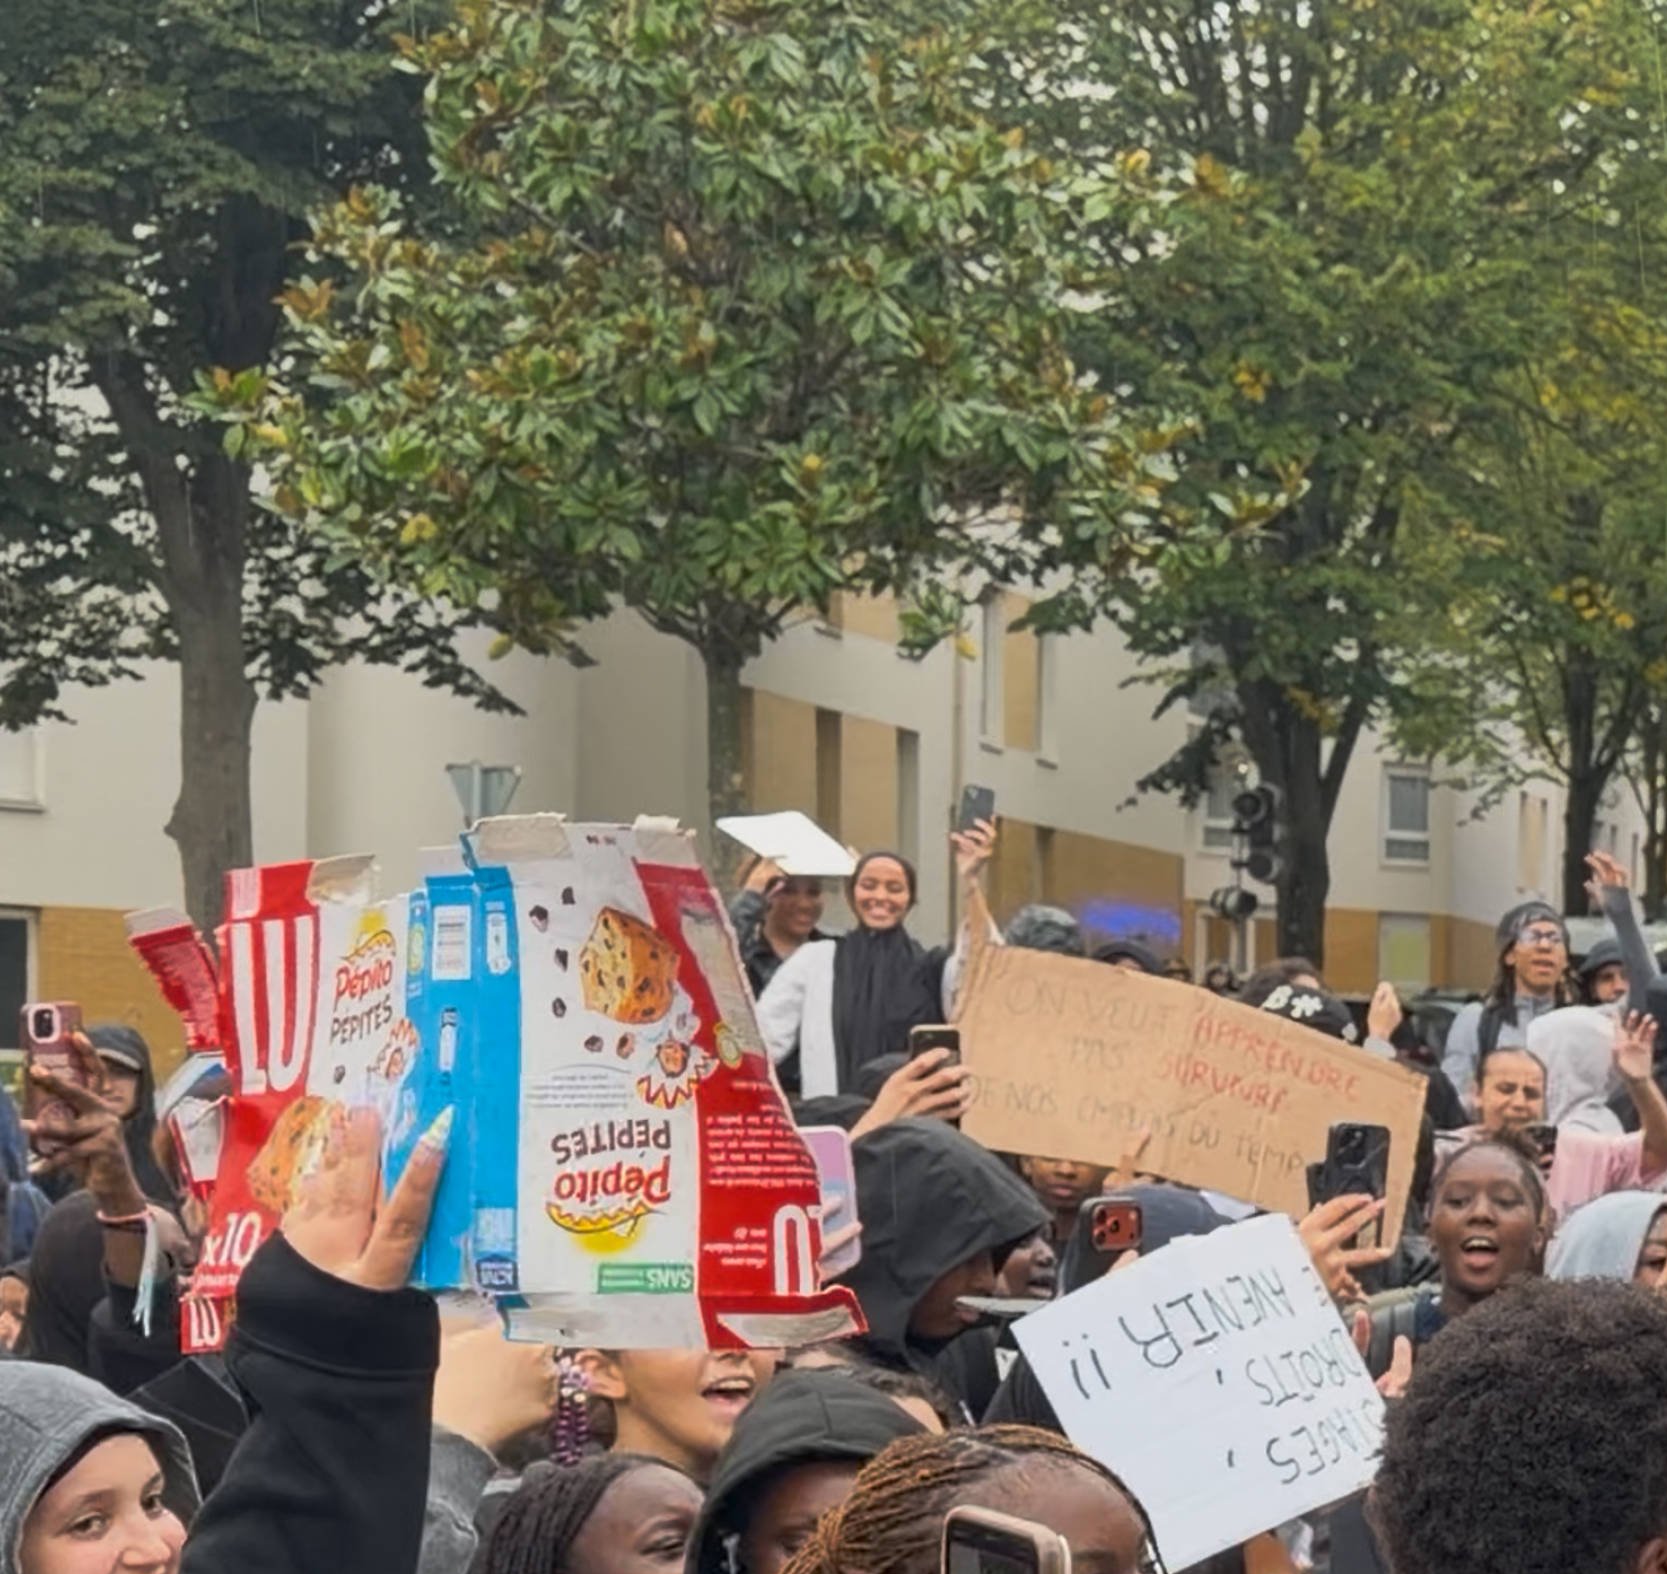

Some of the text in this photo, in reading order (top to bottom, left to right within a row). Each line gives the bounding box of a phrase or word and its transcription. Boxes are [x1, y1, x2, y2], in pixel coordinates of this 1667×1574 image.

[229, 914, 315, 1096] LU
[333, 957, 393, 1012] Pépito
[1193, 1014, 1361, 1101] APPRENDRE
[551, 1117, 672, 1164] PÉPITES
[1189, 1119, 1221, 1149] DU
[1235, 1132, 1305, 1172] TEMP
[553, 1155, 673, 1207] Pépito
[646, 1268, 693, 1290] SANS
[1118, 1264, 1297, 1369] AVENIR
